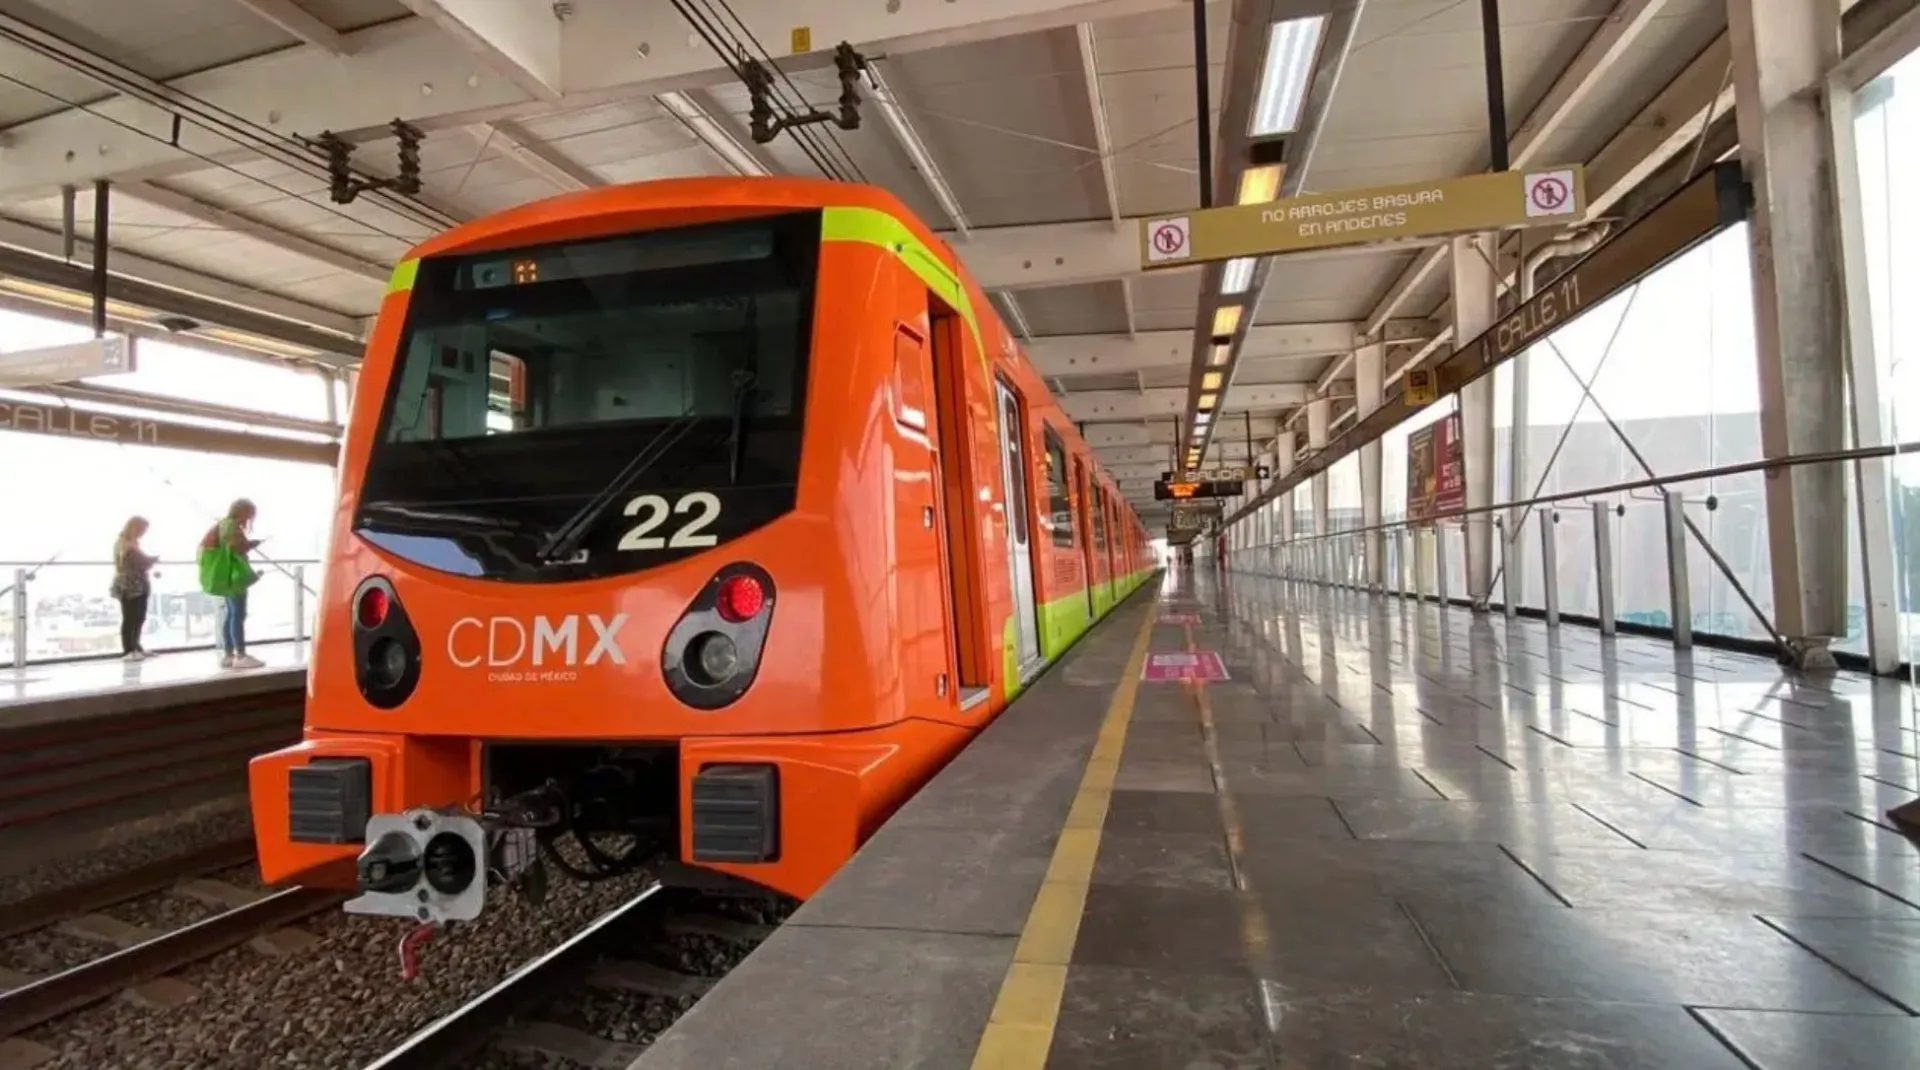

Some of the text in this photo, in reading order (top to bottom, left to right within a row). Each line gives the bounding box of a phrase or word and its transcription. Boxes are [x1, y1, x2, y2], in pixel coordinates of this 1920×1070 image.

[1262, 189, 1444, 222] NO ARROJES BASURA
[1299, 212, 1407, 236] EN ANDENES
[1498, 275, 1580, 352] CALLE 11
[129, 420, 158, 444] 11
[617, 491, 721, 551] 22
[447, 613, 629, 668] CDMX
[525, 673, 538, 682] DE
